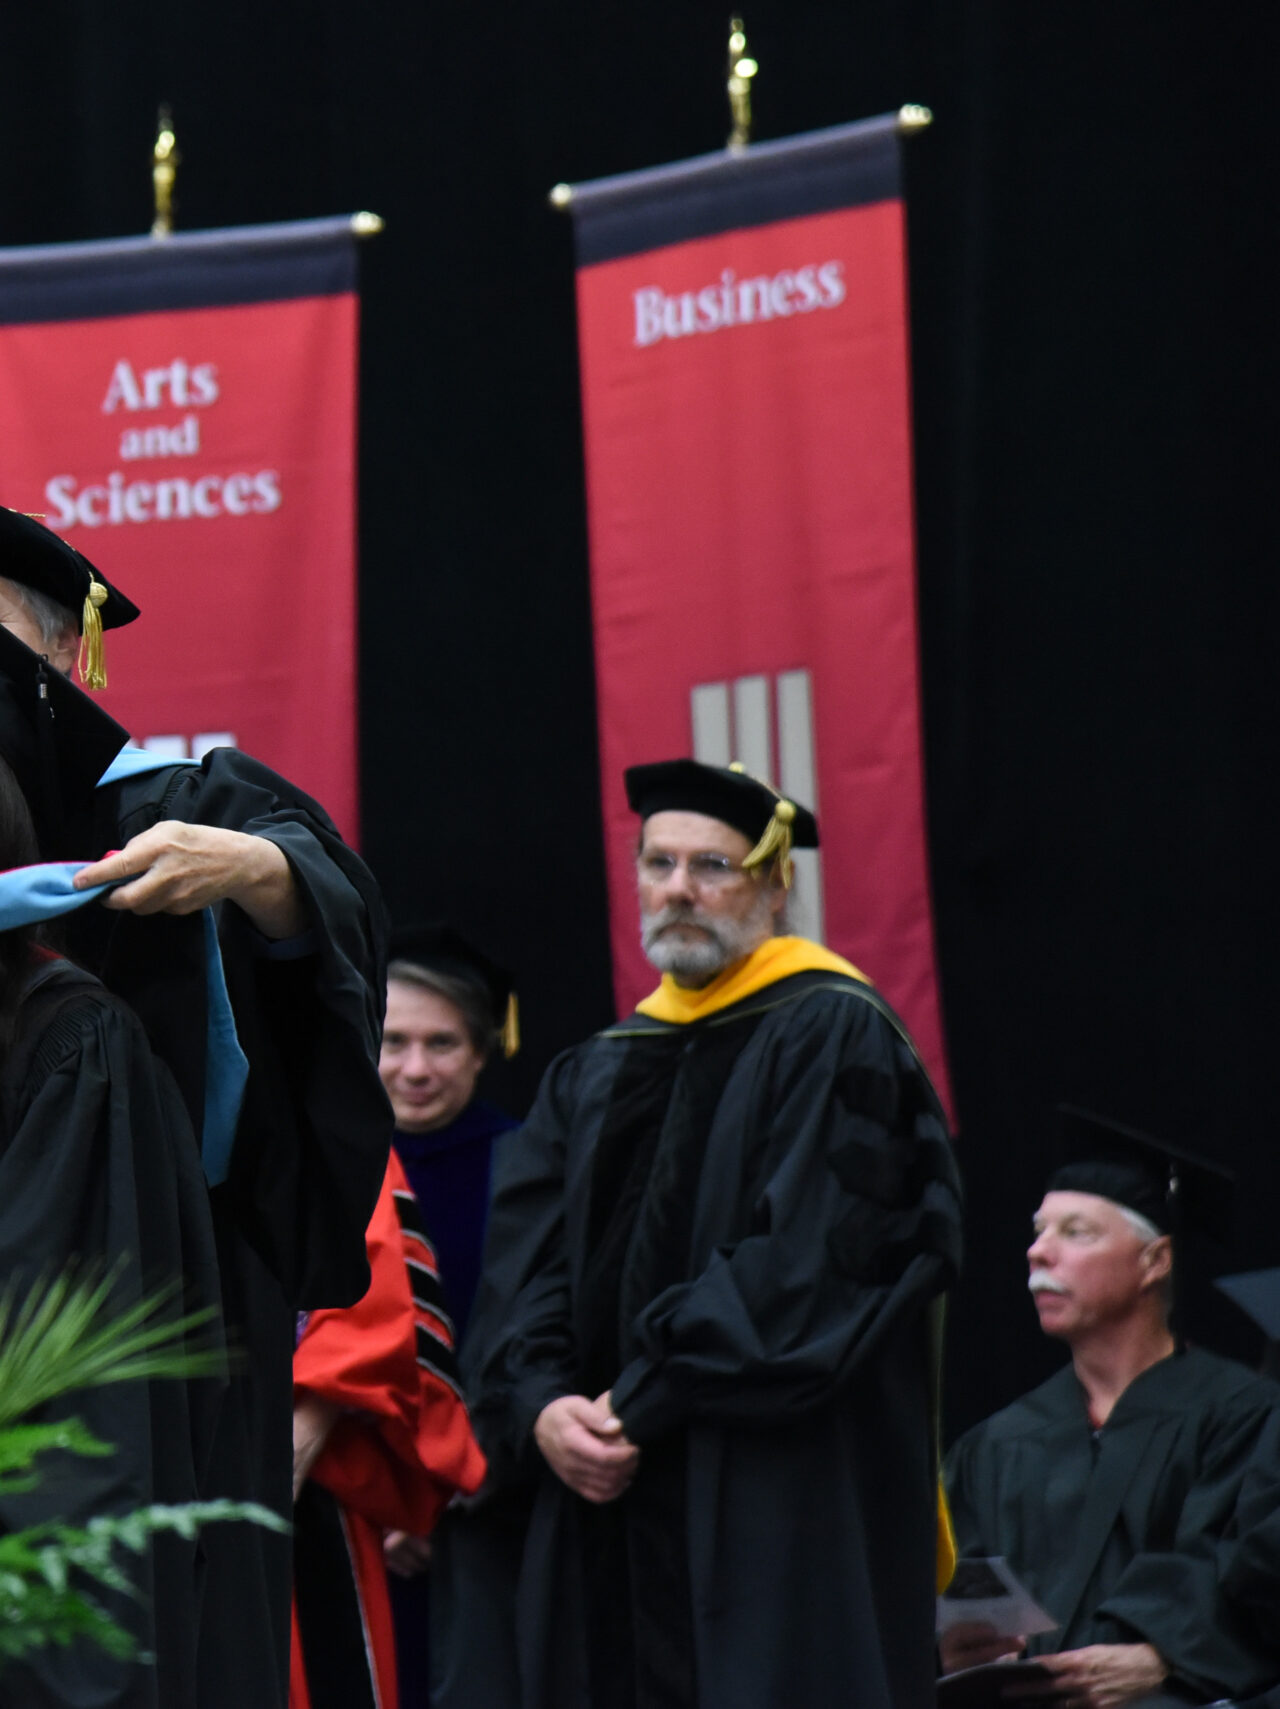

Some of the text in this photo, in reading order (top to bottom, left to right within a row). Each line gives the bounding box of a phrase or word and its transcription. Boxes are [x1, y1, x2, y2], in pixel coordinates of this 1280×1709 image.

[633, 259, 846, 347] Business
[102, 358, 219, 414] Arts
[120, 413, 200, 461] and
[45, 468, 281, 529] Sciences
